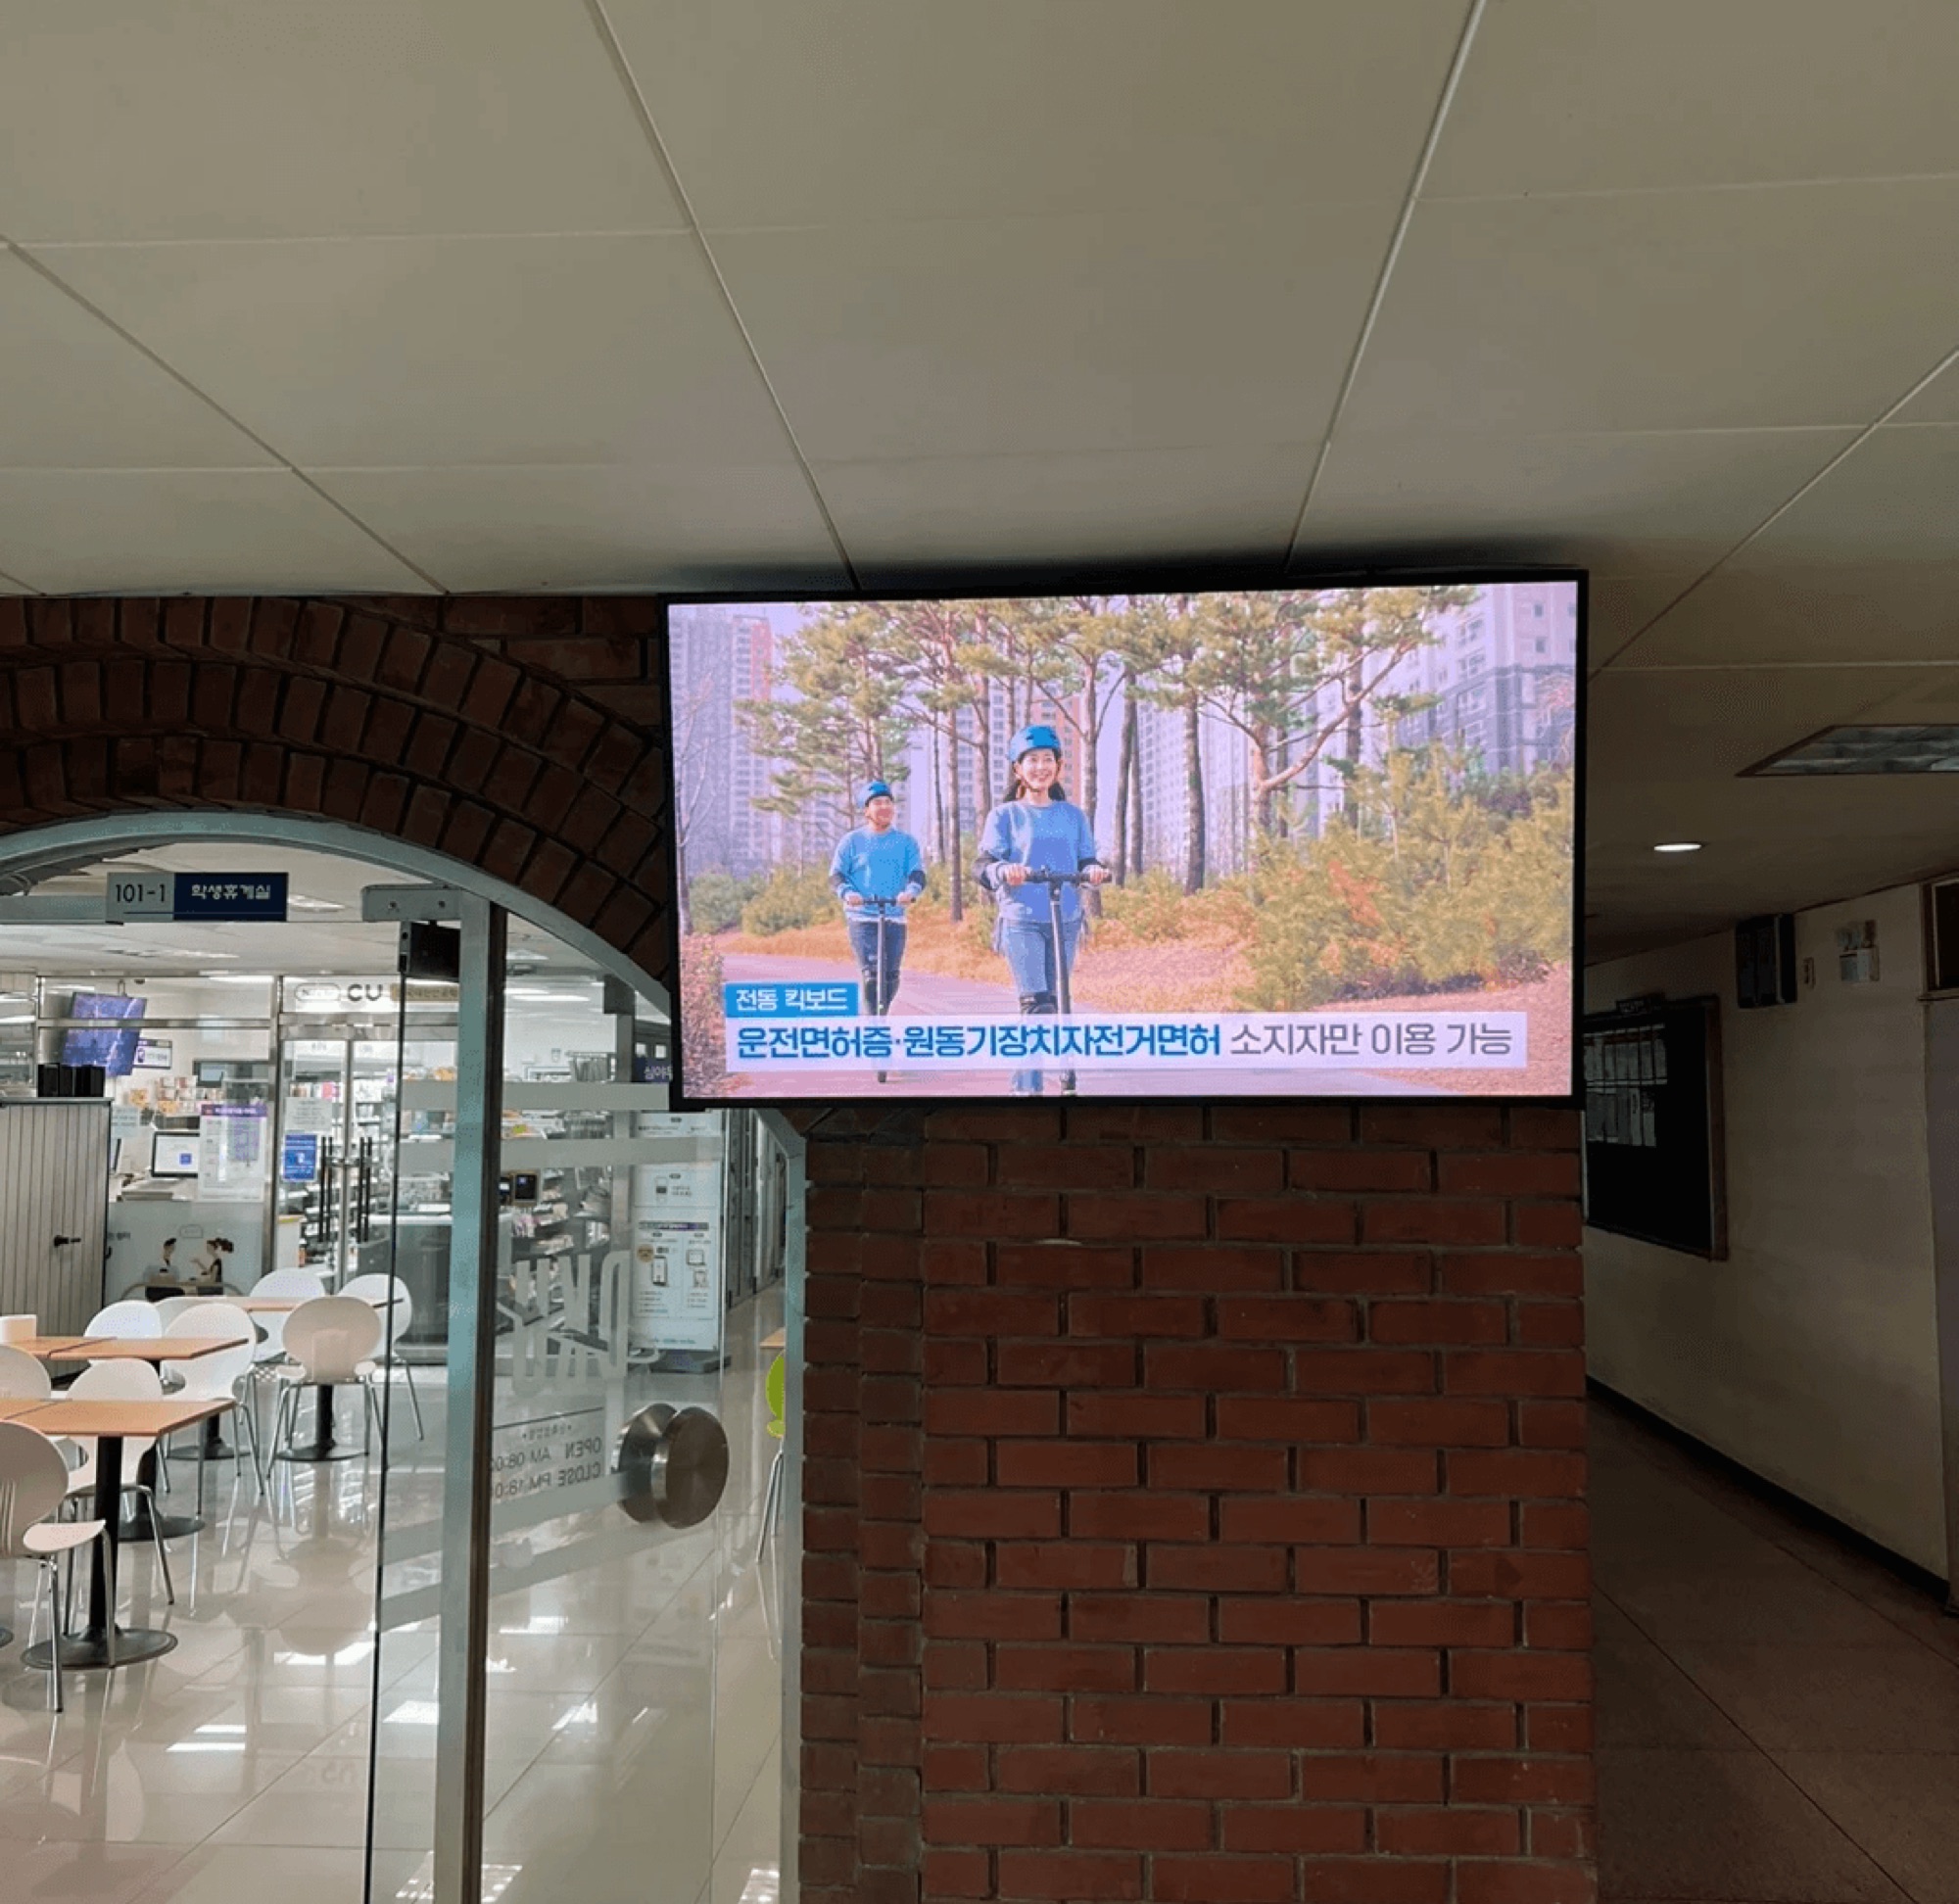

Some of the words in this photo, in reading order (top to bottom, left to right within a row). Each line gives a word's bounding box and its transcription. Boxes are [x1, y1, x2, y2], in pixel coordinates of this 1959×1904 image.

[115, 883, 167, 904] 101-1
[191, 883, 271, 901] 학생휴게실
[347, 983, 383, 1002] CU
[736, 987, 778, 1012] 전동
[785, 987, 848, 1012] 킥보드
[1230, 1023, 1363, 1056] 소지자만
[1371, 1023, 1436, 1056] 이용
[1447, 1023, 1513, 1056] 가능
